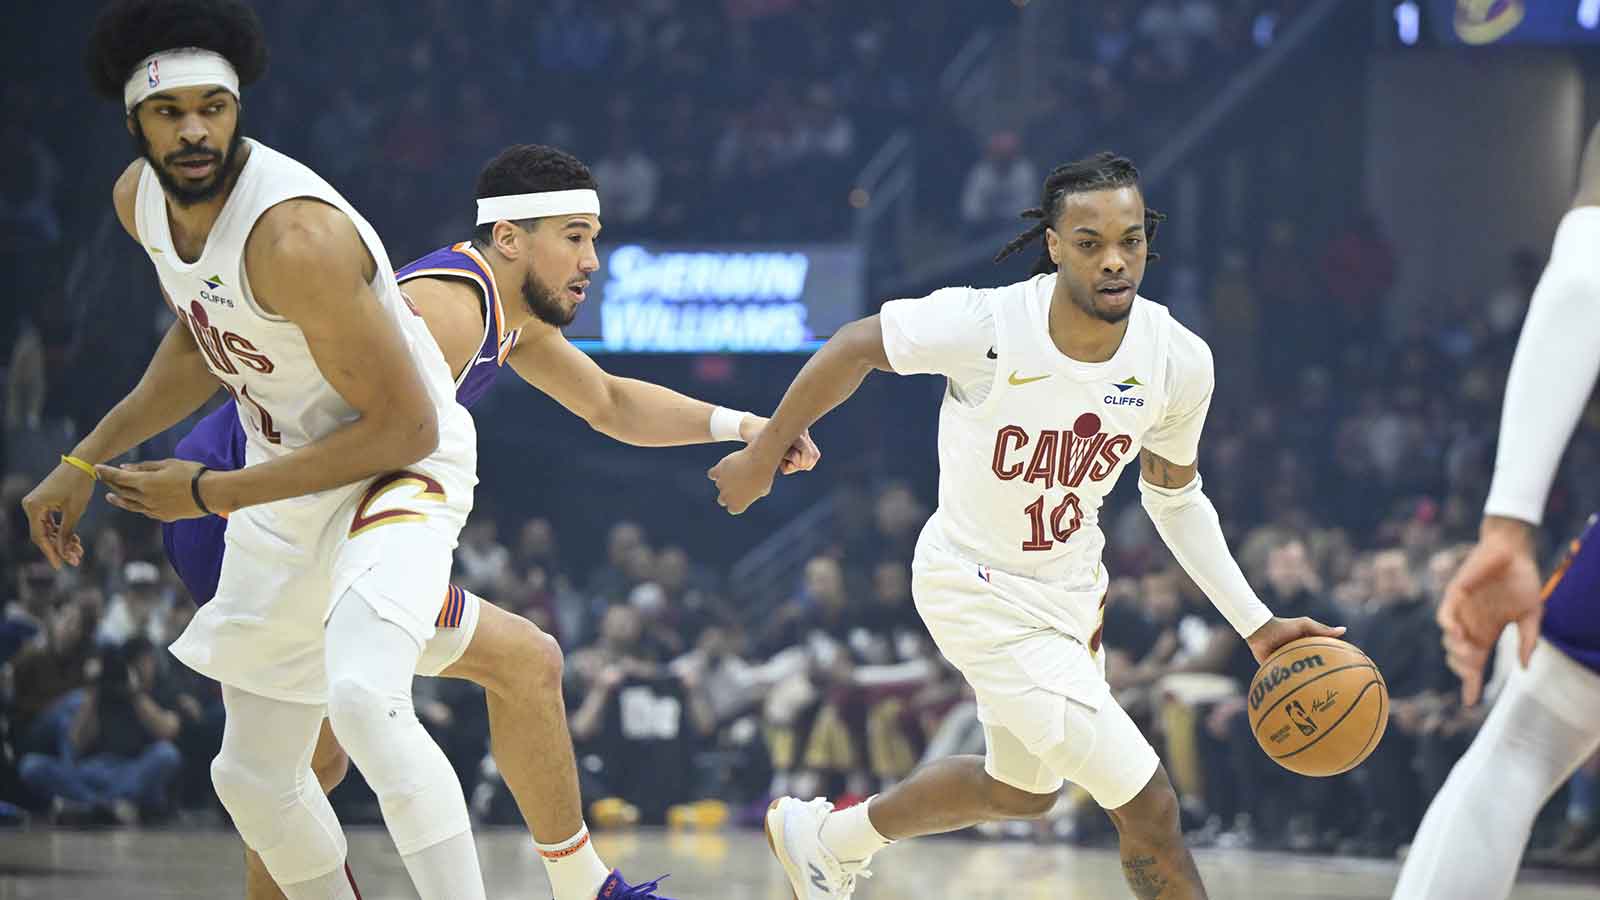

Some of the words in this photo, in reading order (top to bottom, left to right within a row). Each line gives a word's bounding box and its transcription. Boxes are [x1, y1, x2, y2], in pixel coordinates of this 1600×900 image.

[200, 290, 234, 308] CLIFFS
[1103, 394, 1145, 408] CLIFFS
[991, 423, 1133, 490] CAVS
[1022, 491, 1084, 551] 10
[1250, 654, 1326, 710] Wilson
